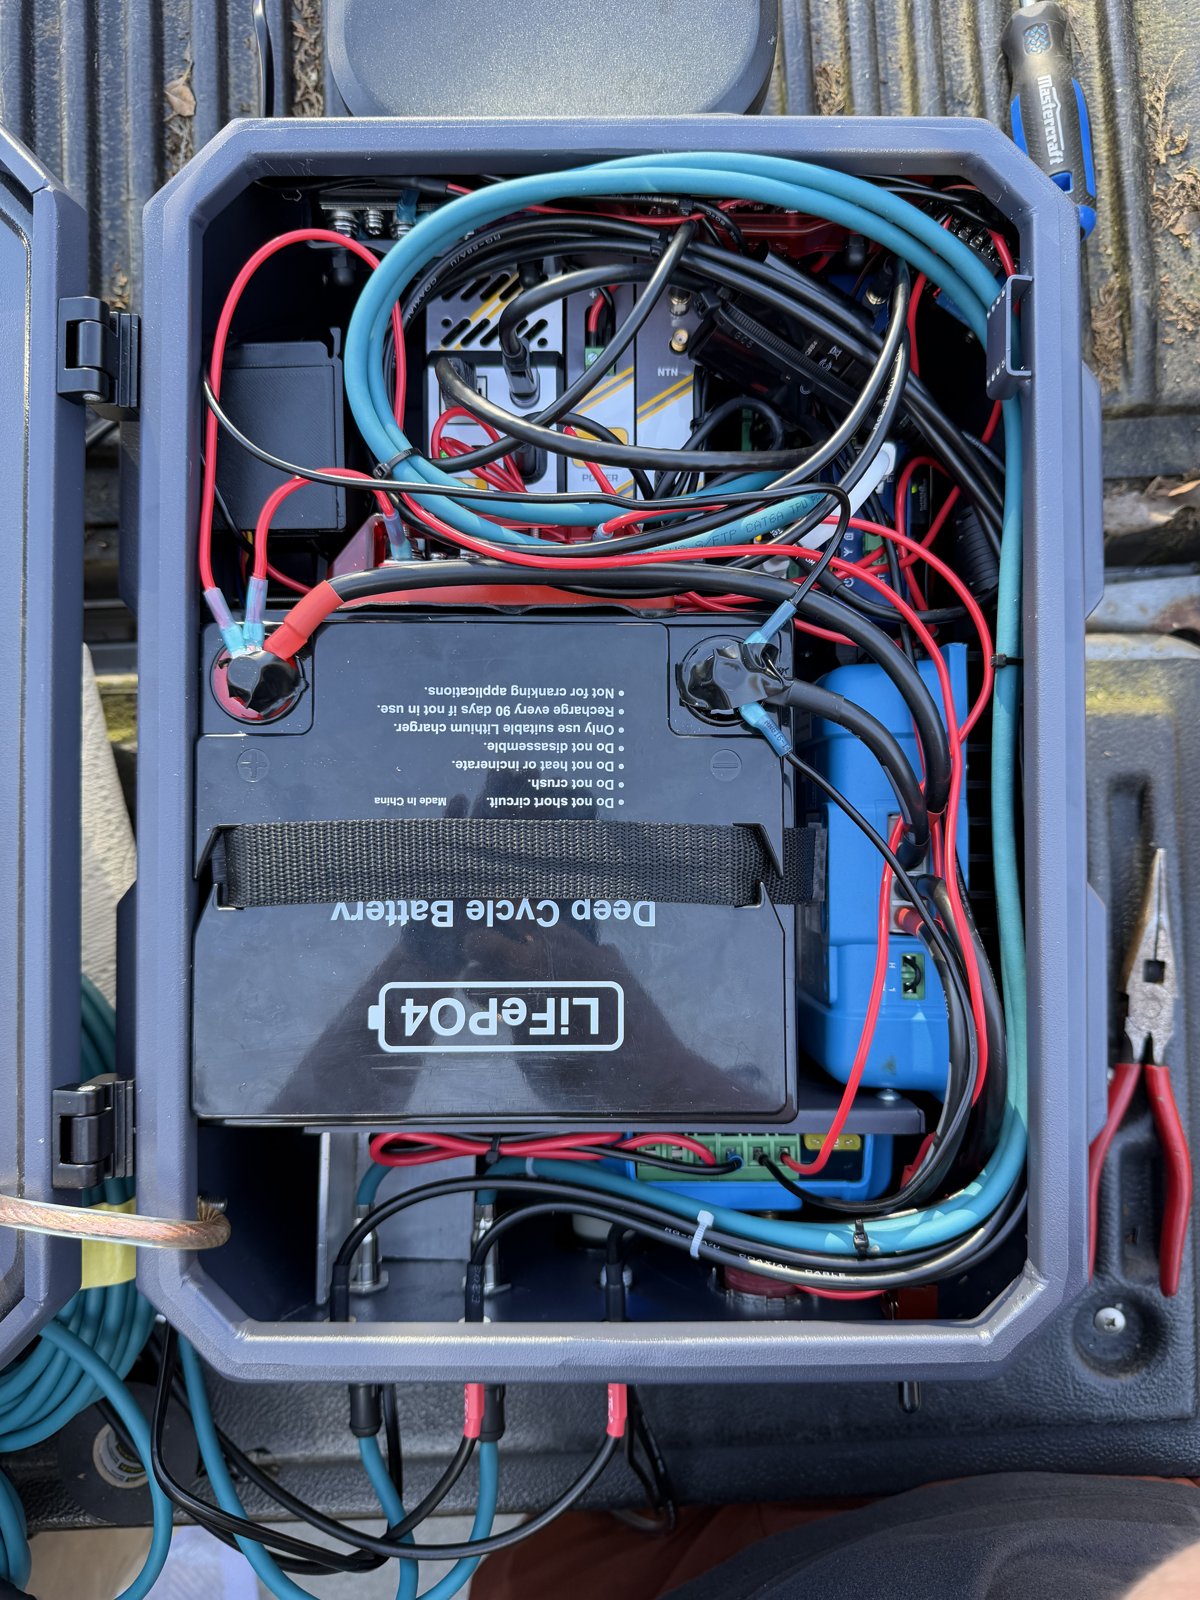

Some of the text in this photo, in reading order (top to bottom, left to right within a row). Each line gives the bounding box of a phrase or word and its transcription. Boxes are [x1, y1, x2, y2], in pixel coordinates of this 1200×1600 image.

[657, 366, 679, 377] NTN
[424, 685, 614, 699] Not for cranking applications.
[377, 703, 614, 717] Recharge every 90 days if not in use.
[393, 721, 614, 736] Only use suitable Lithium charger.
[483, 742, 614, 754] Do not disassemble.
[452, 760, 614, 773] Do not heat or incinerate.
[528, 778, 614, 791] Do not crush.
[374, 797, 405, 807] China
[419, 797, 447, 807] Made
[486, 797, 614, 809] Do not short circuit.
[330, 898, 656, 928] Deep Cycle Battery
[400, 997, 600, 1037] LiFePO4
